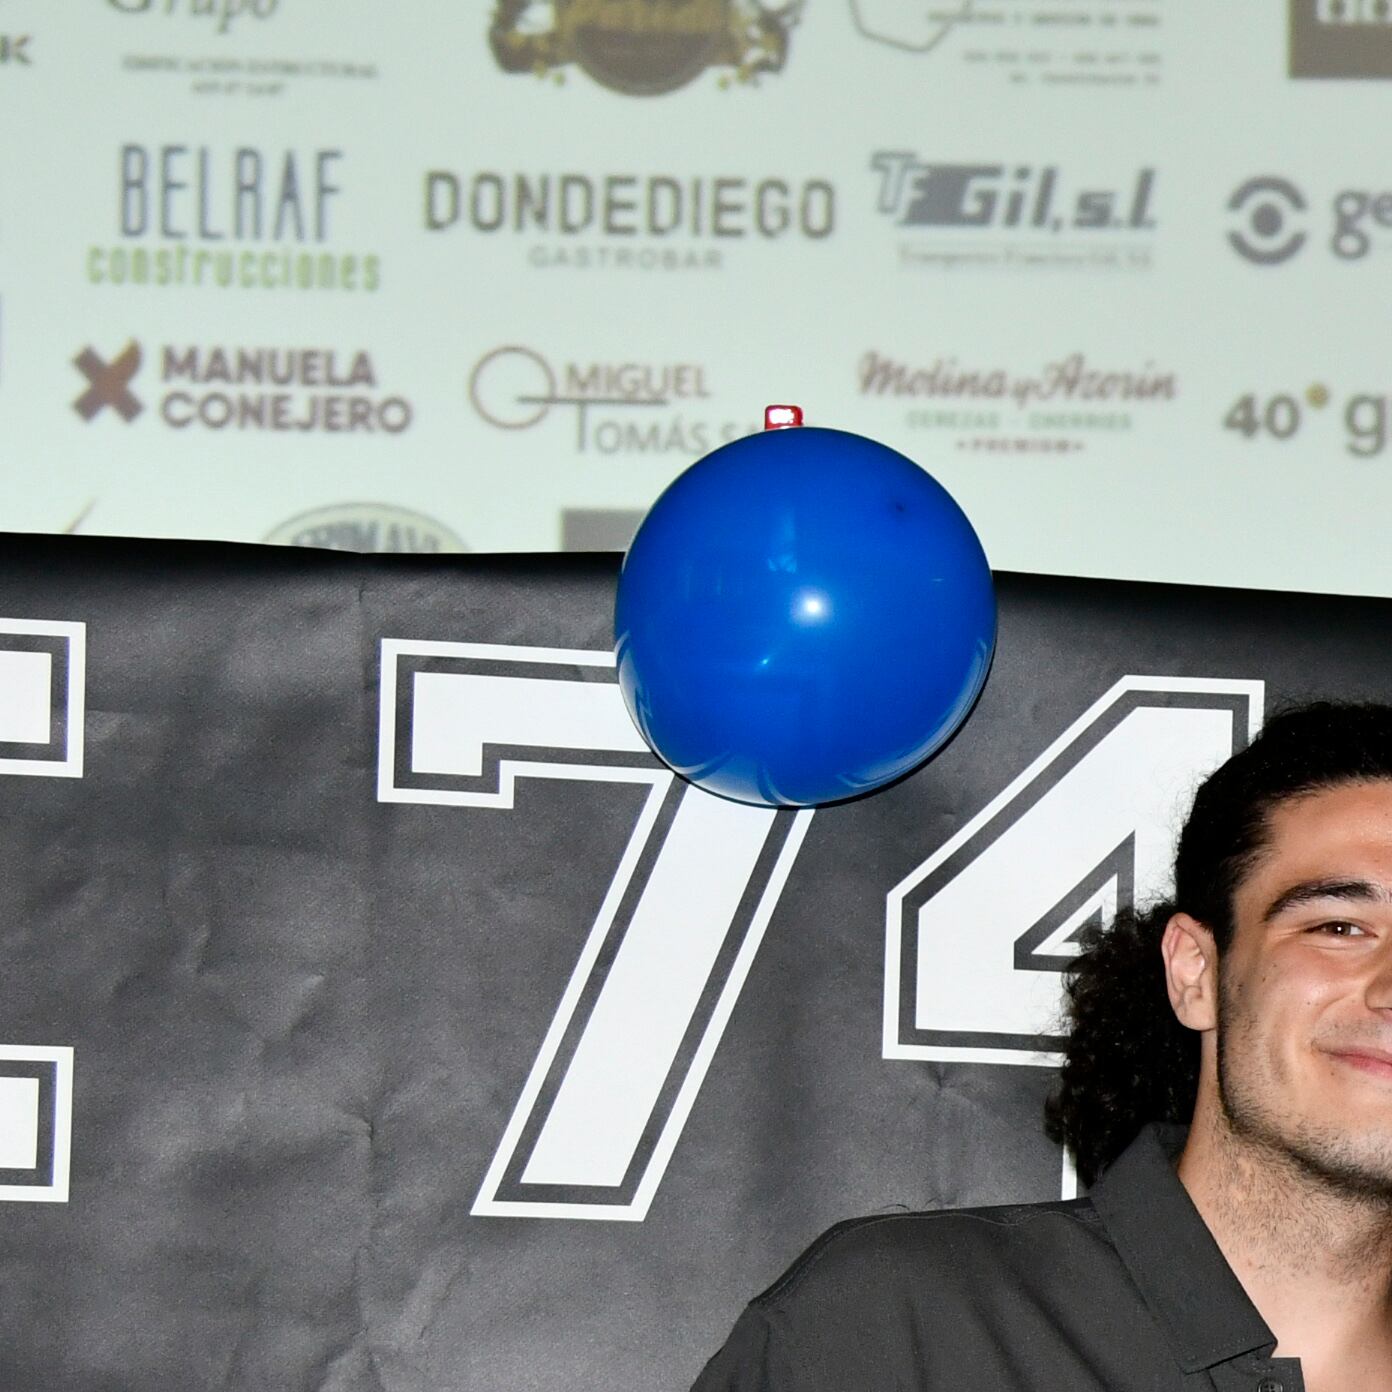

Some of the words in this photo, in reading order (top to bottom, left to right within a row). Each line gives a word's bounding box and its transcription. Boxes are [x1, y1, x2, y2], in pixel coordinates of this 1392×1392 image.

[118, 145, 343, 242] BELRAF
[425, 169, 837, 240] DONDEDIEGO
[87, 246, 380, 292] construcciones
[528, 244, 724, 271] GASTROBAR
[161, 345, 376, 387] MANUELA
[564, 364, 711, 399] MIGUEL
[857, 350, 1007, 398] Molina
[160, 392, 413, 435] CONEJERO
[562, 397, 709, 454] TOMÁS
[378, 638, 1265, 1221] 74
